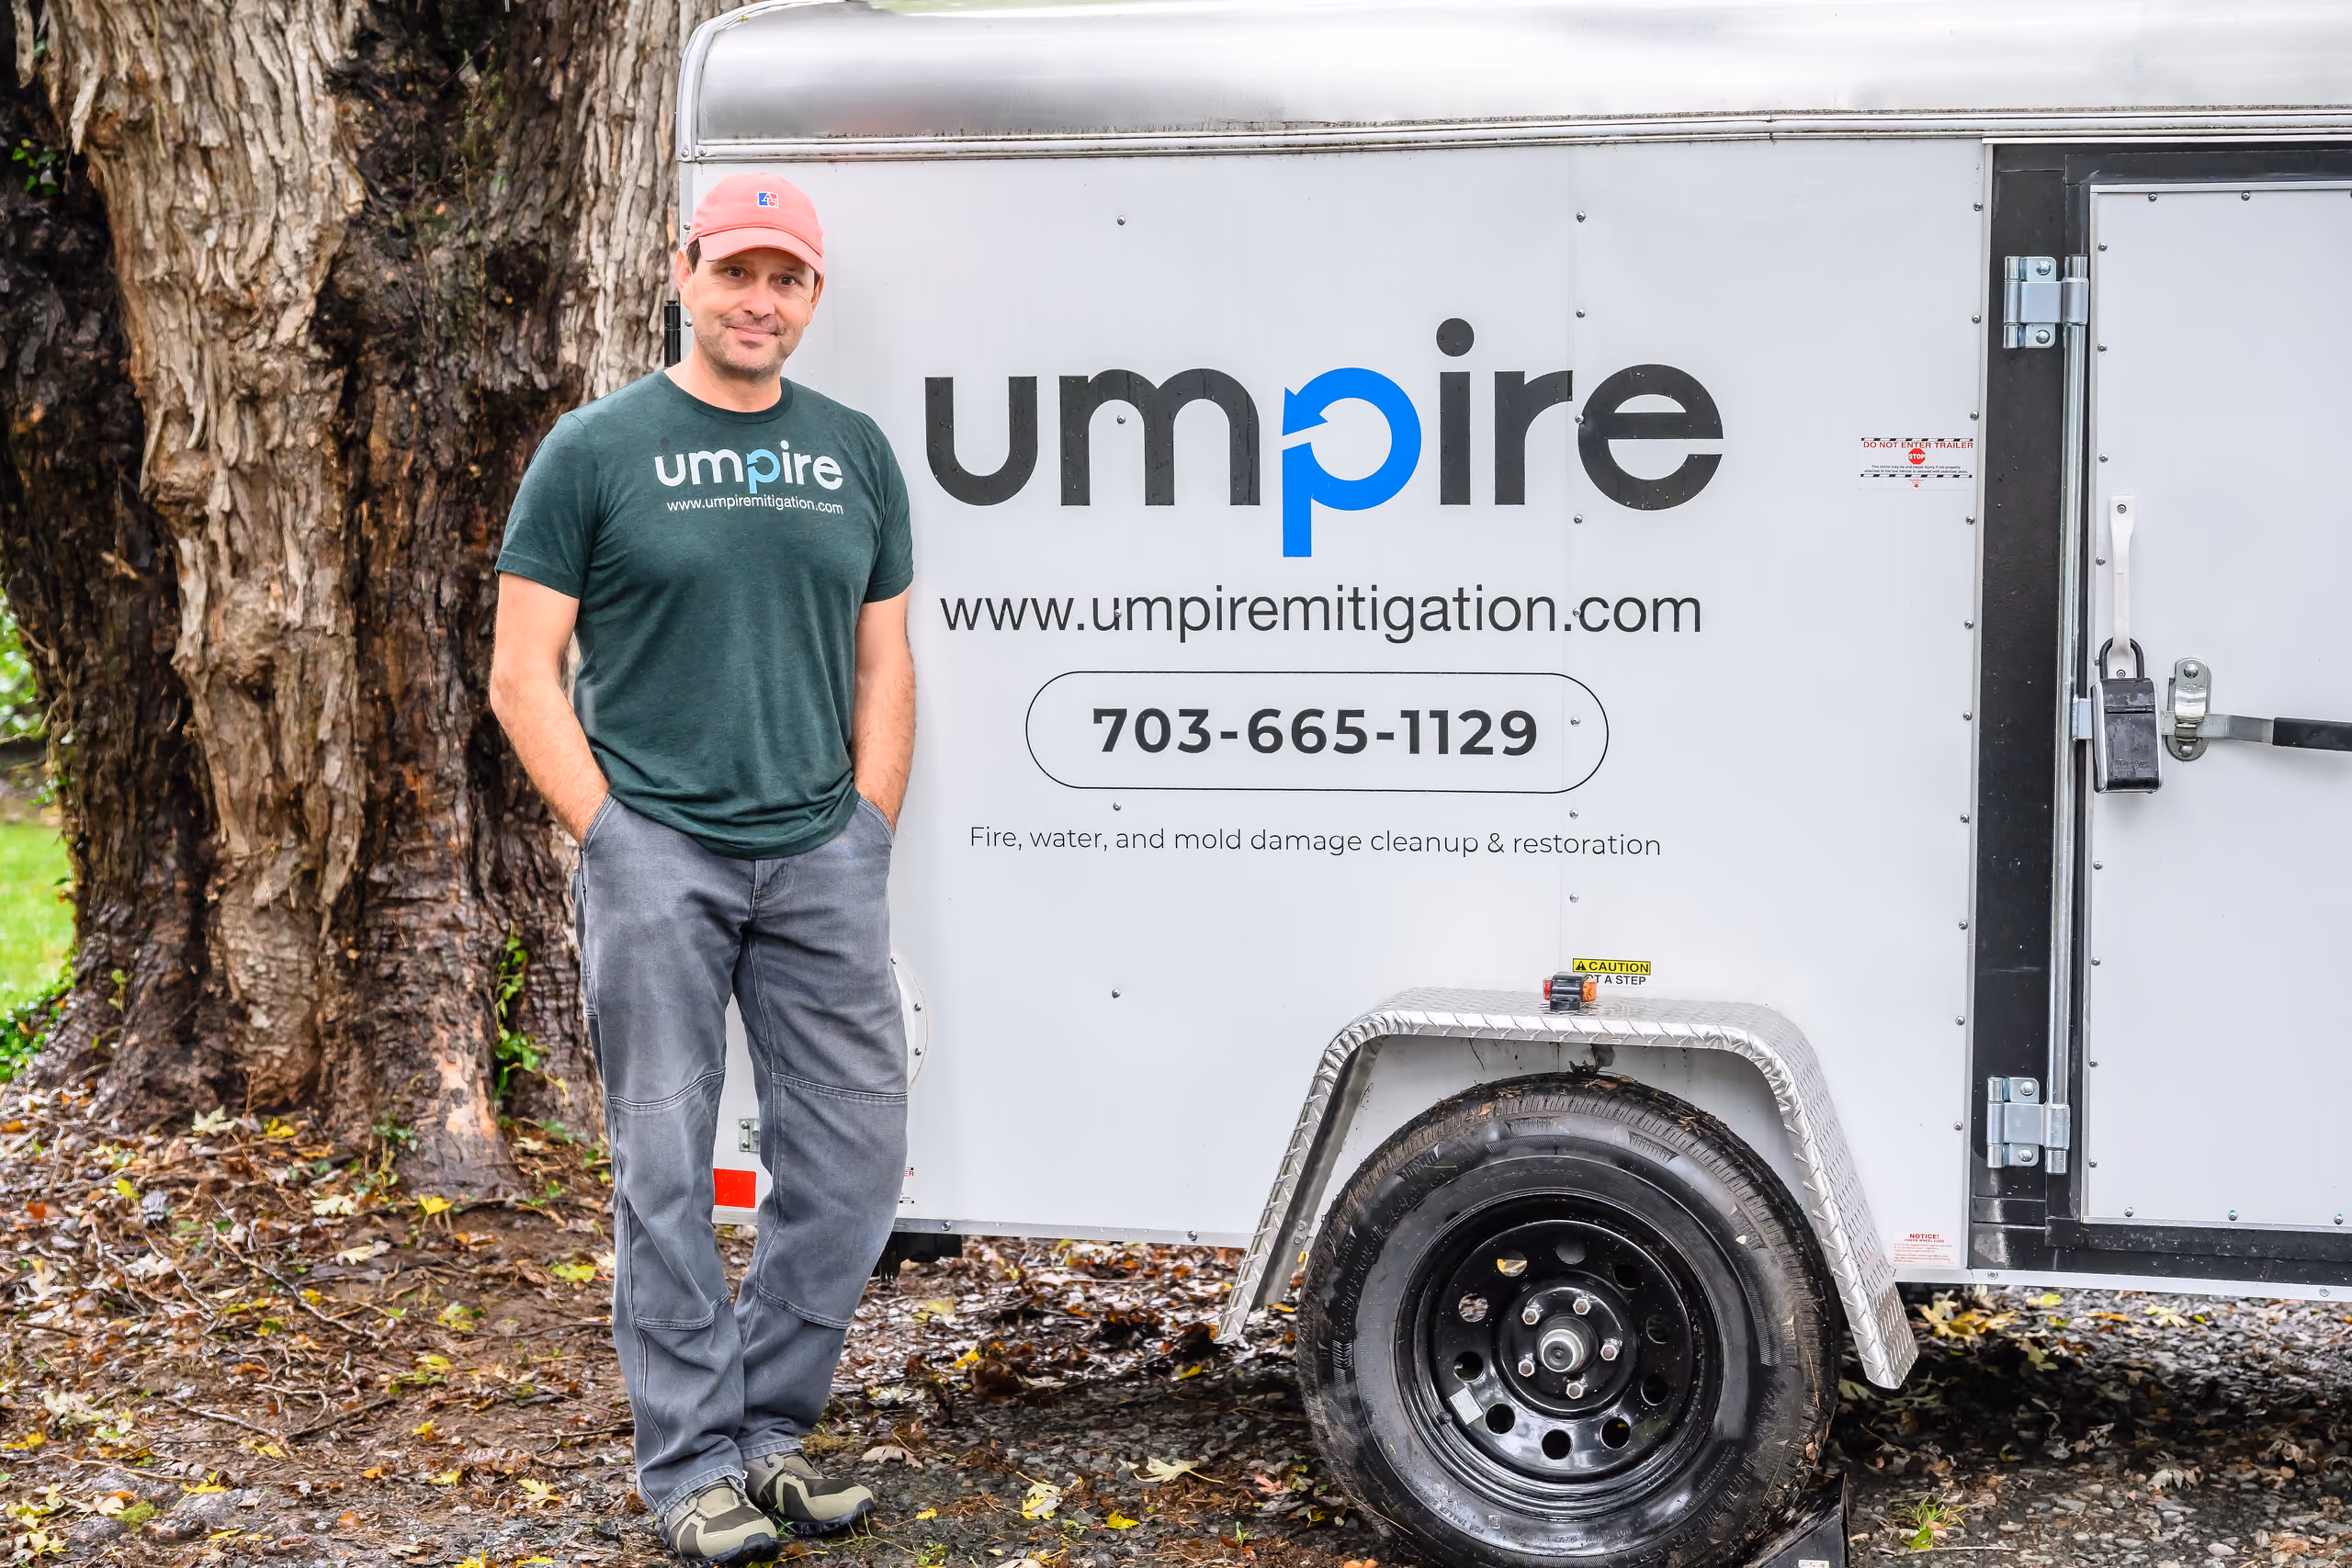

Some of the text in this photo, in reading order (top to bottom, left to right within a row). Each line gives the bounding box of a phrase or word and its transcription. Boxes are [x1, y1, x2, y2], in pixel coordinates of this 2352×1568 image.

[925, 318, 1723, 557] umpire
[654, 440, 843, 494] umpire
[667, 494, 844, 515] www.umpiremitigation.com
[940, 584, 1700, 643] www.umpiremitigation.com
[1093, 708, 1538, 756] 703-665-1129
[970, 826, 1661, 857] Fire, water, and mold damage cleanup & restoration
[1589, 961, 1648, 973] CAUTION
[1604, 975, 1612, 984] A
[1615, 975, 1646, 985] STEP
